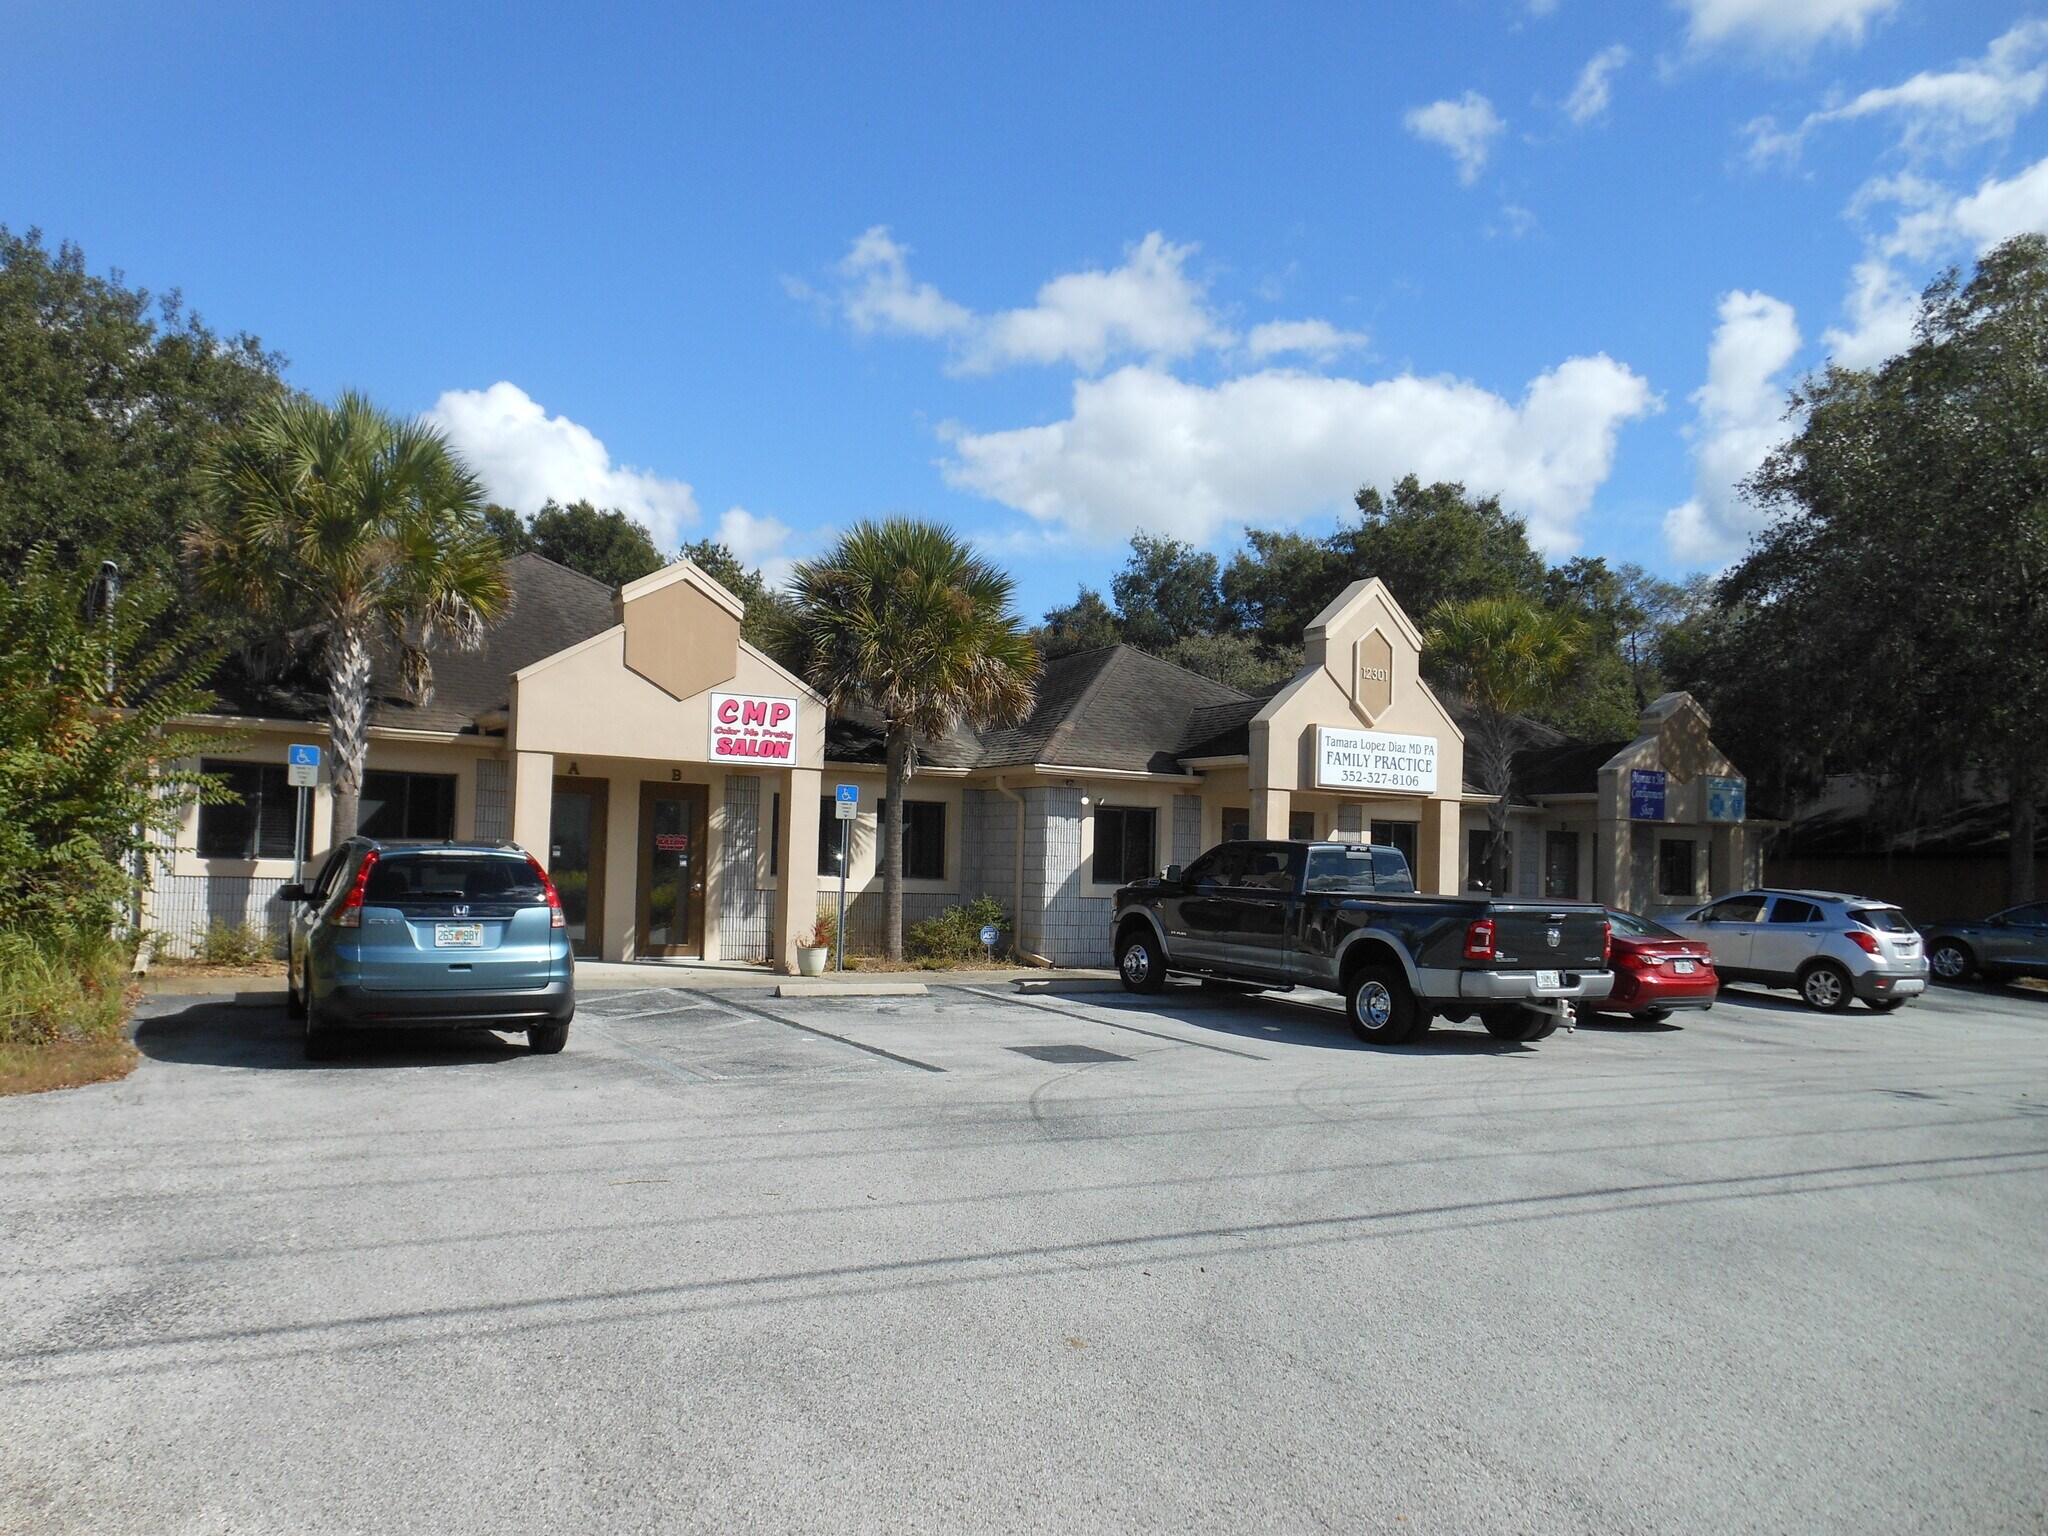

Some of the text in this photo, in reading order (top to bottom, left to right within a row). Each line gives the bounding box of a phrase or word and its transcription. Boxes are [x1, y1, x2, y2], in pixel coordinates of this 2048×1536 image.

[1361, 666, 1388, 682] 12301
[717, 699, 791, 727] CMP
[713, 726, 741, 736] Color
[743, 728, 759, 737] Me
[715, 737, 791, 759] SALON
[1325, 735, 1435, 756] Tamara Lopez Diaz MD PA
[567, 762, 580, 775] A
[1326, 751, 1433, 773] FAMILY PRACTICE
[671, 769, 681, 781] B
[1341, 770, 1419, 787] 352-327-8106
[438, 930, 454, 941] 265
